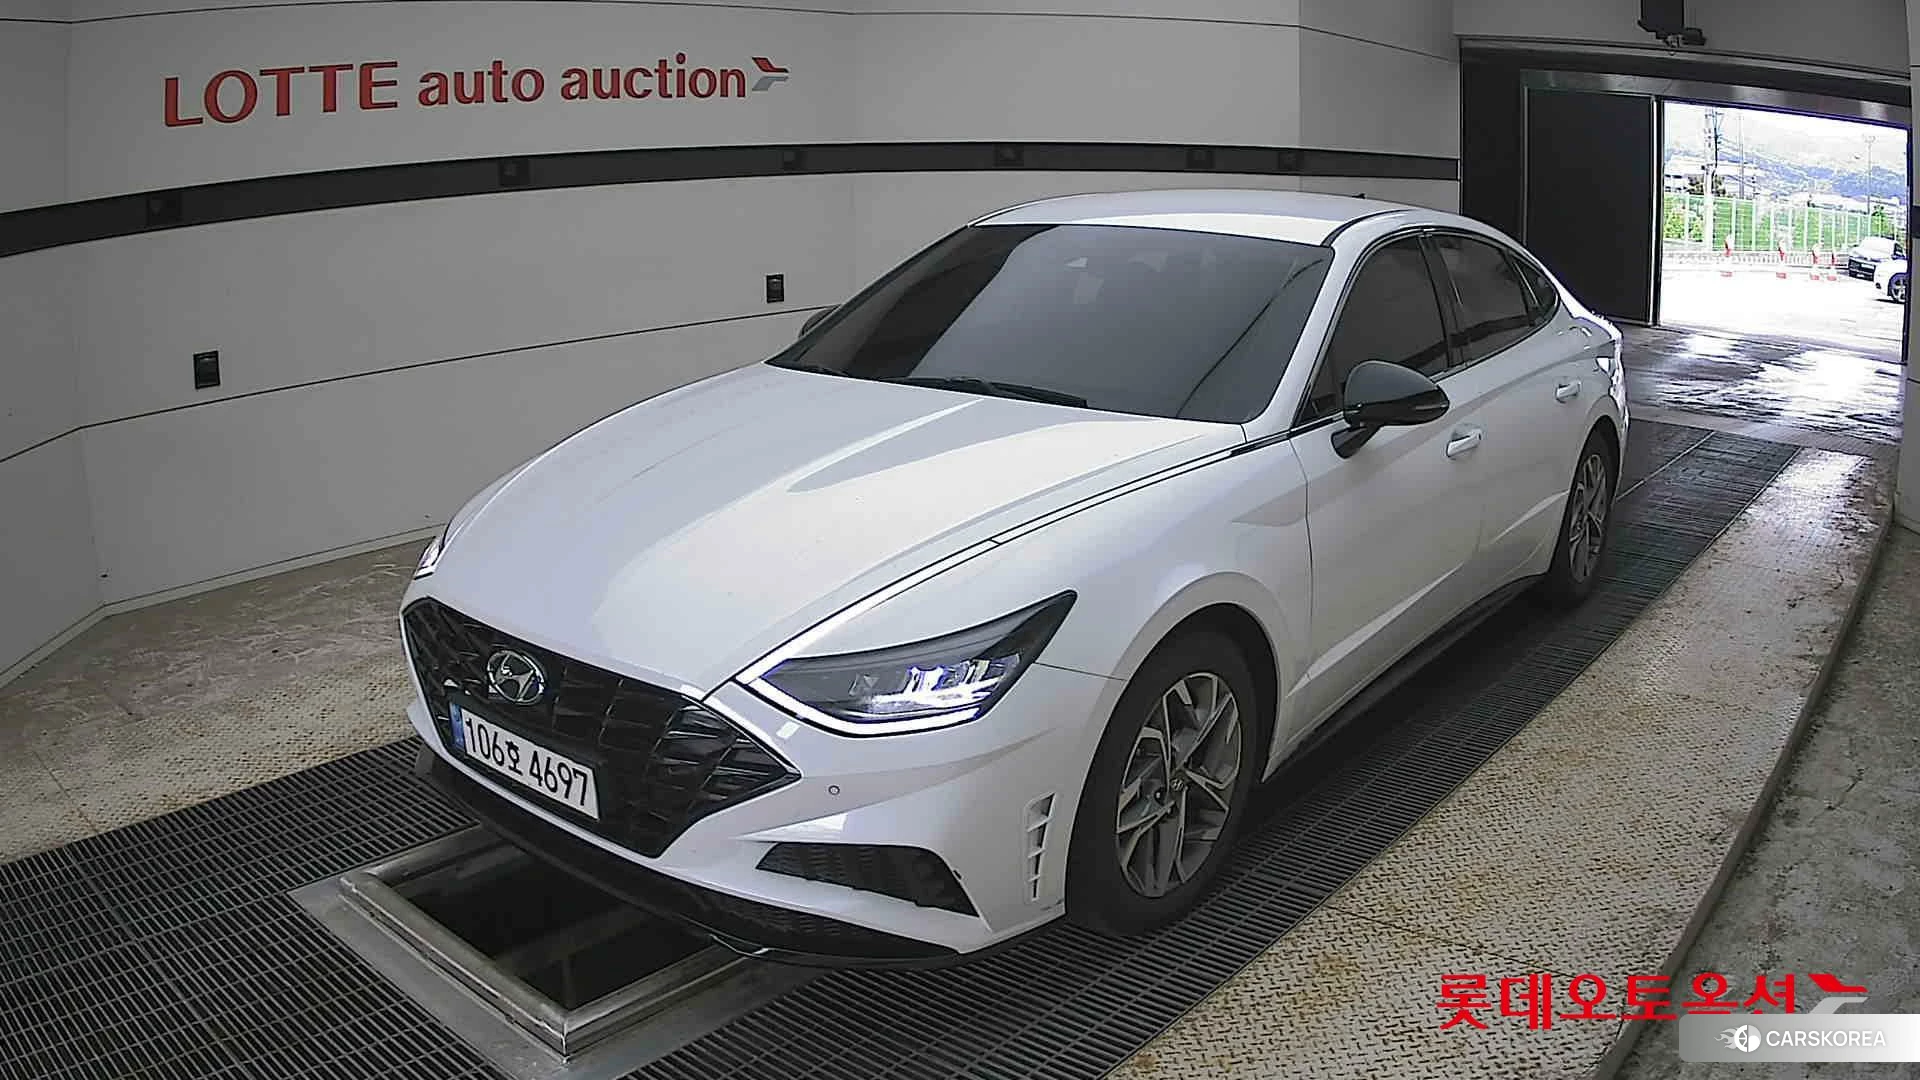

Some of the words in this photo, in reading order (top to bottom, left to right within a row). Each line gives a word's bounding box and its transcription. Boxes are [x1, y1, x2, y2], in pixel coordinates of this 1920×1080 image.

[163, 61, 399, 127] LOTTE
[418, 60, 545, 107] auto
[560, 53, 747, 102] auction
[465, 717, 523, 777] 106호
[529, 750, 588, 806] 4697
